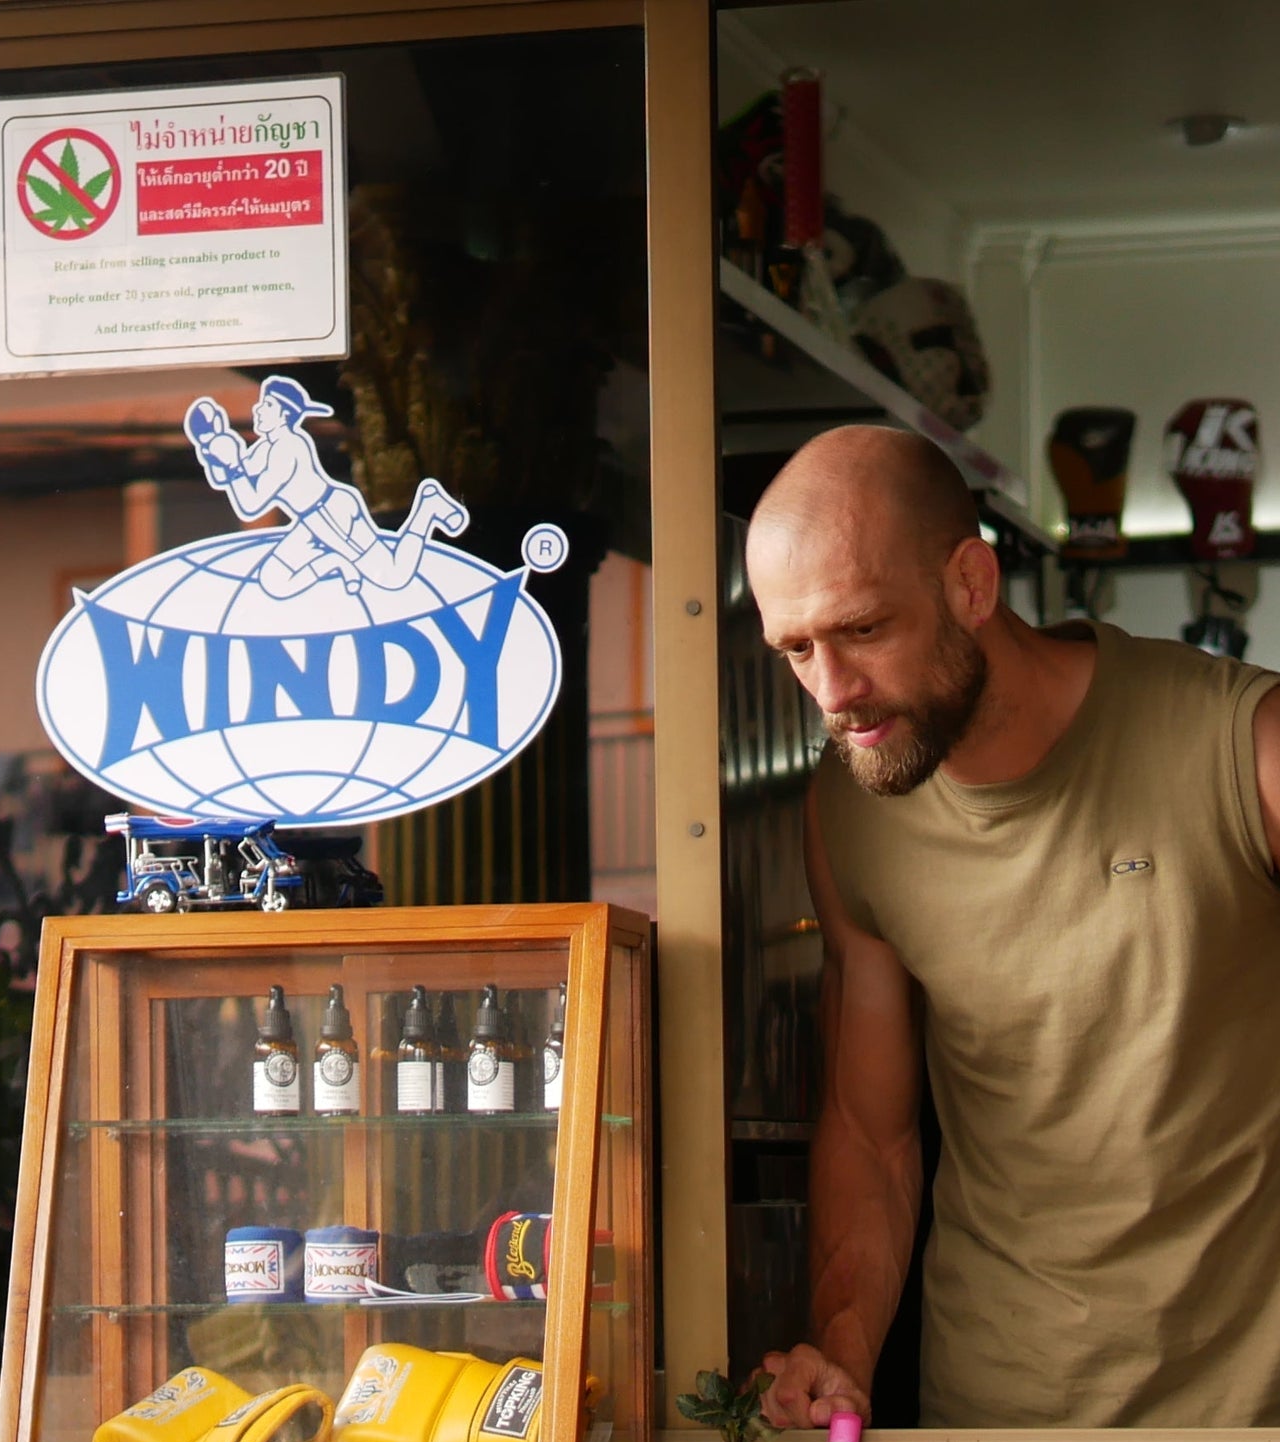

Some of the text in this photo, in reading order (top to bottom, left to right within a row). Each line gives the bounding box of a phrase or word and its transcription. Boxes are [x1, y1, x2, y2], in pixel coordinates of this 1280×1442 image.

[264, 158, 290, 179] 20
[294, 159, 308, 177] ปี
[54, 249, 281, 272] Refrain from selling cannabis product to
[48, 293, 85, 307] People
[88, 292, 121, 303] under
[125, 290, 137, 300] 20
[140, 289, 170, 302] years
[197, 284, 249, 299] pregnant
[94, 323, 118, 335] And
[121, 319, 197, 333] breastfeeding
[84, 571, 524, 773] WINDY
